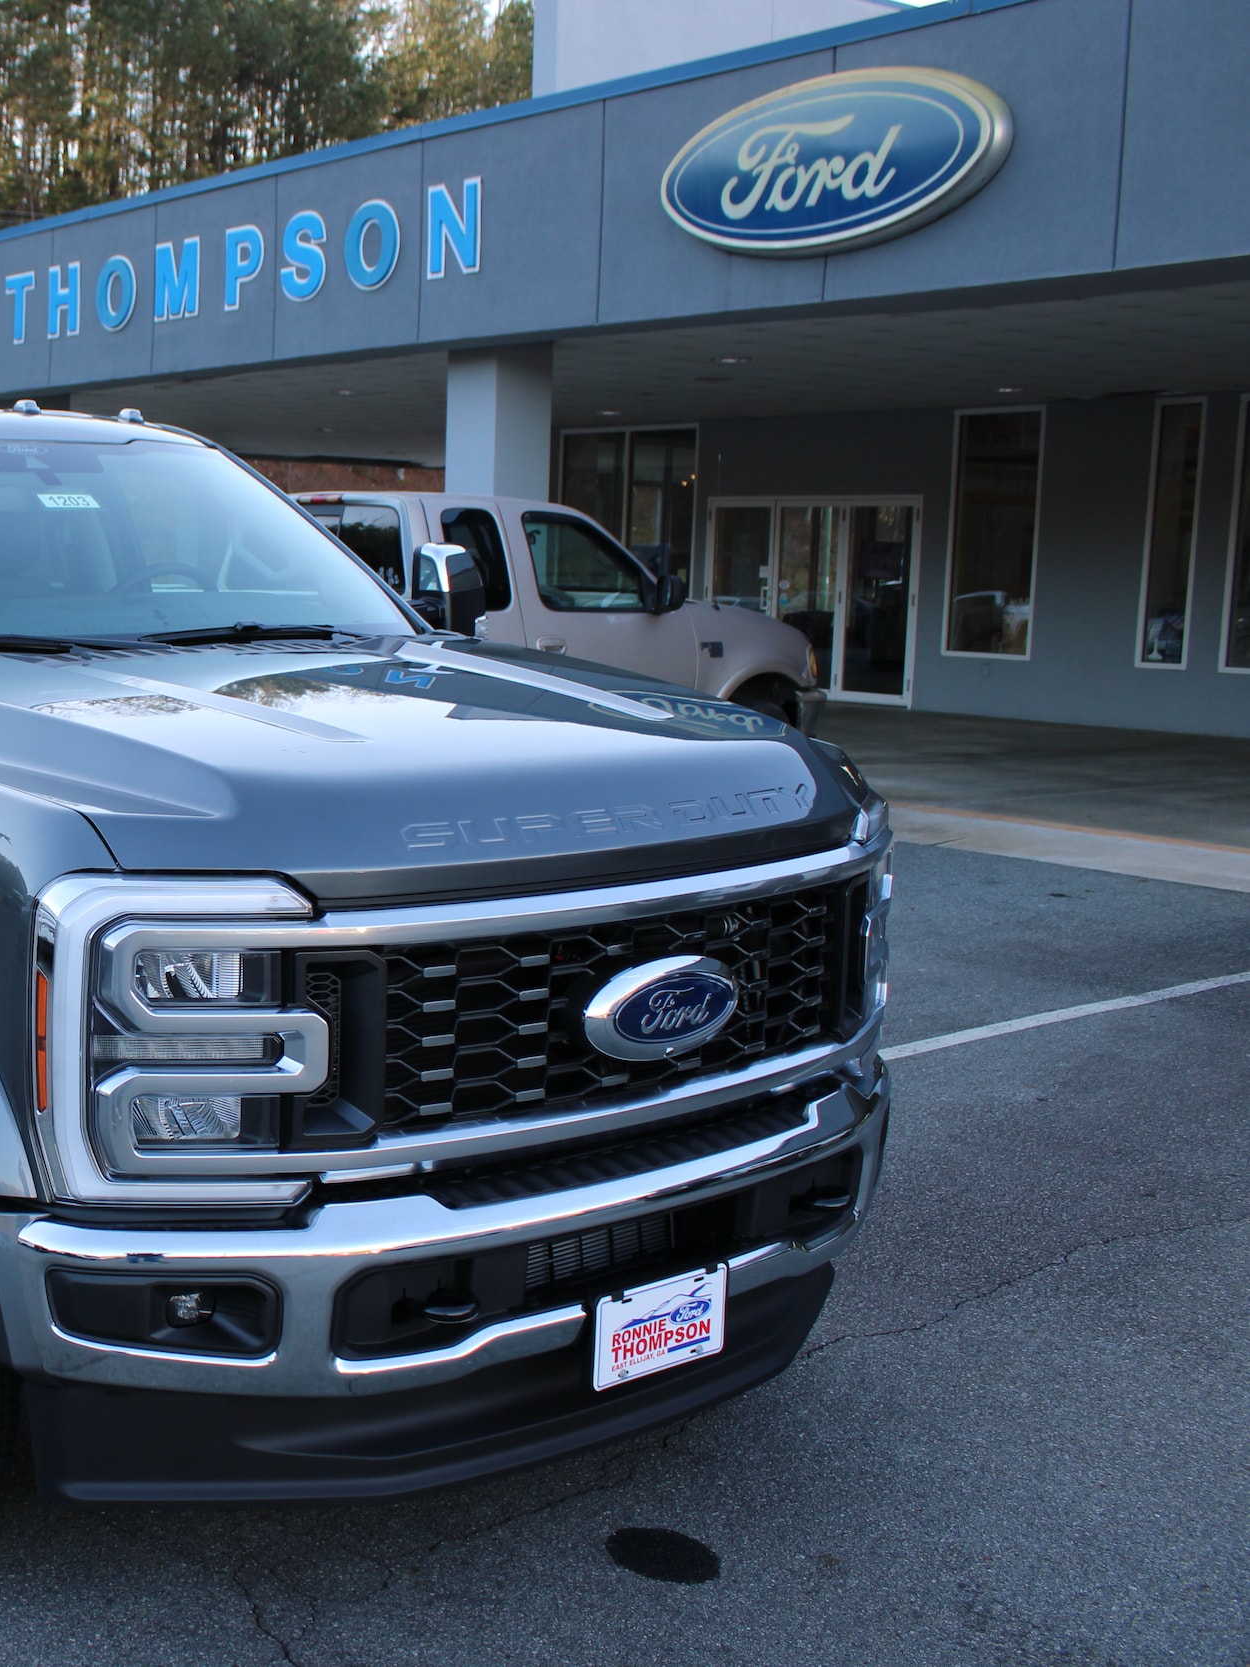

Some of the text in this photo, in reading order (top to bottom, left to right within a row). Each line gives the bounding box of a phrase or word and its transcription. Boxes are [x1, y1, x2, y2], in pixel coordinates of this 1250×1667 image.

[720, 113, 903, 221] Ford
[4, 175, 483, 345] THOMPSON
[48, 495, 91, 507] 1203
[401, 783, 810, 851] SUPER DUTY
[641, 986, 713, 1035] Ford
[612, 1318, 667, 1347] RONNIE
[676, 1301, 704, 1321] Ford
[611, 1318, 712, 1363] THOMPSON
[611, 1349, 666, 1372] EAST ELLIJAY, GA
